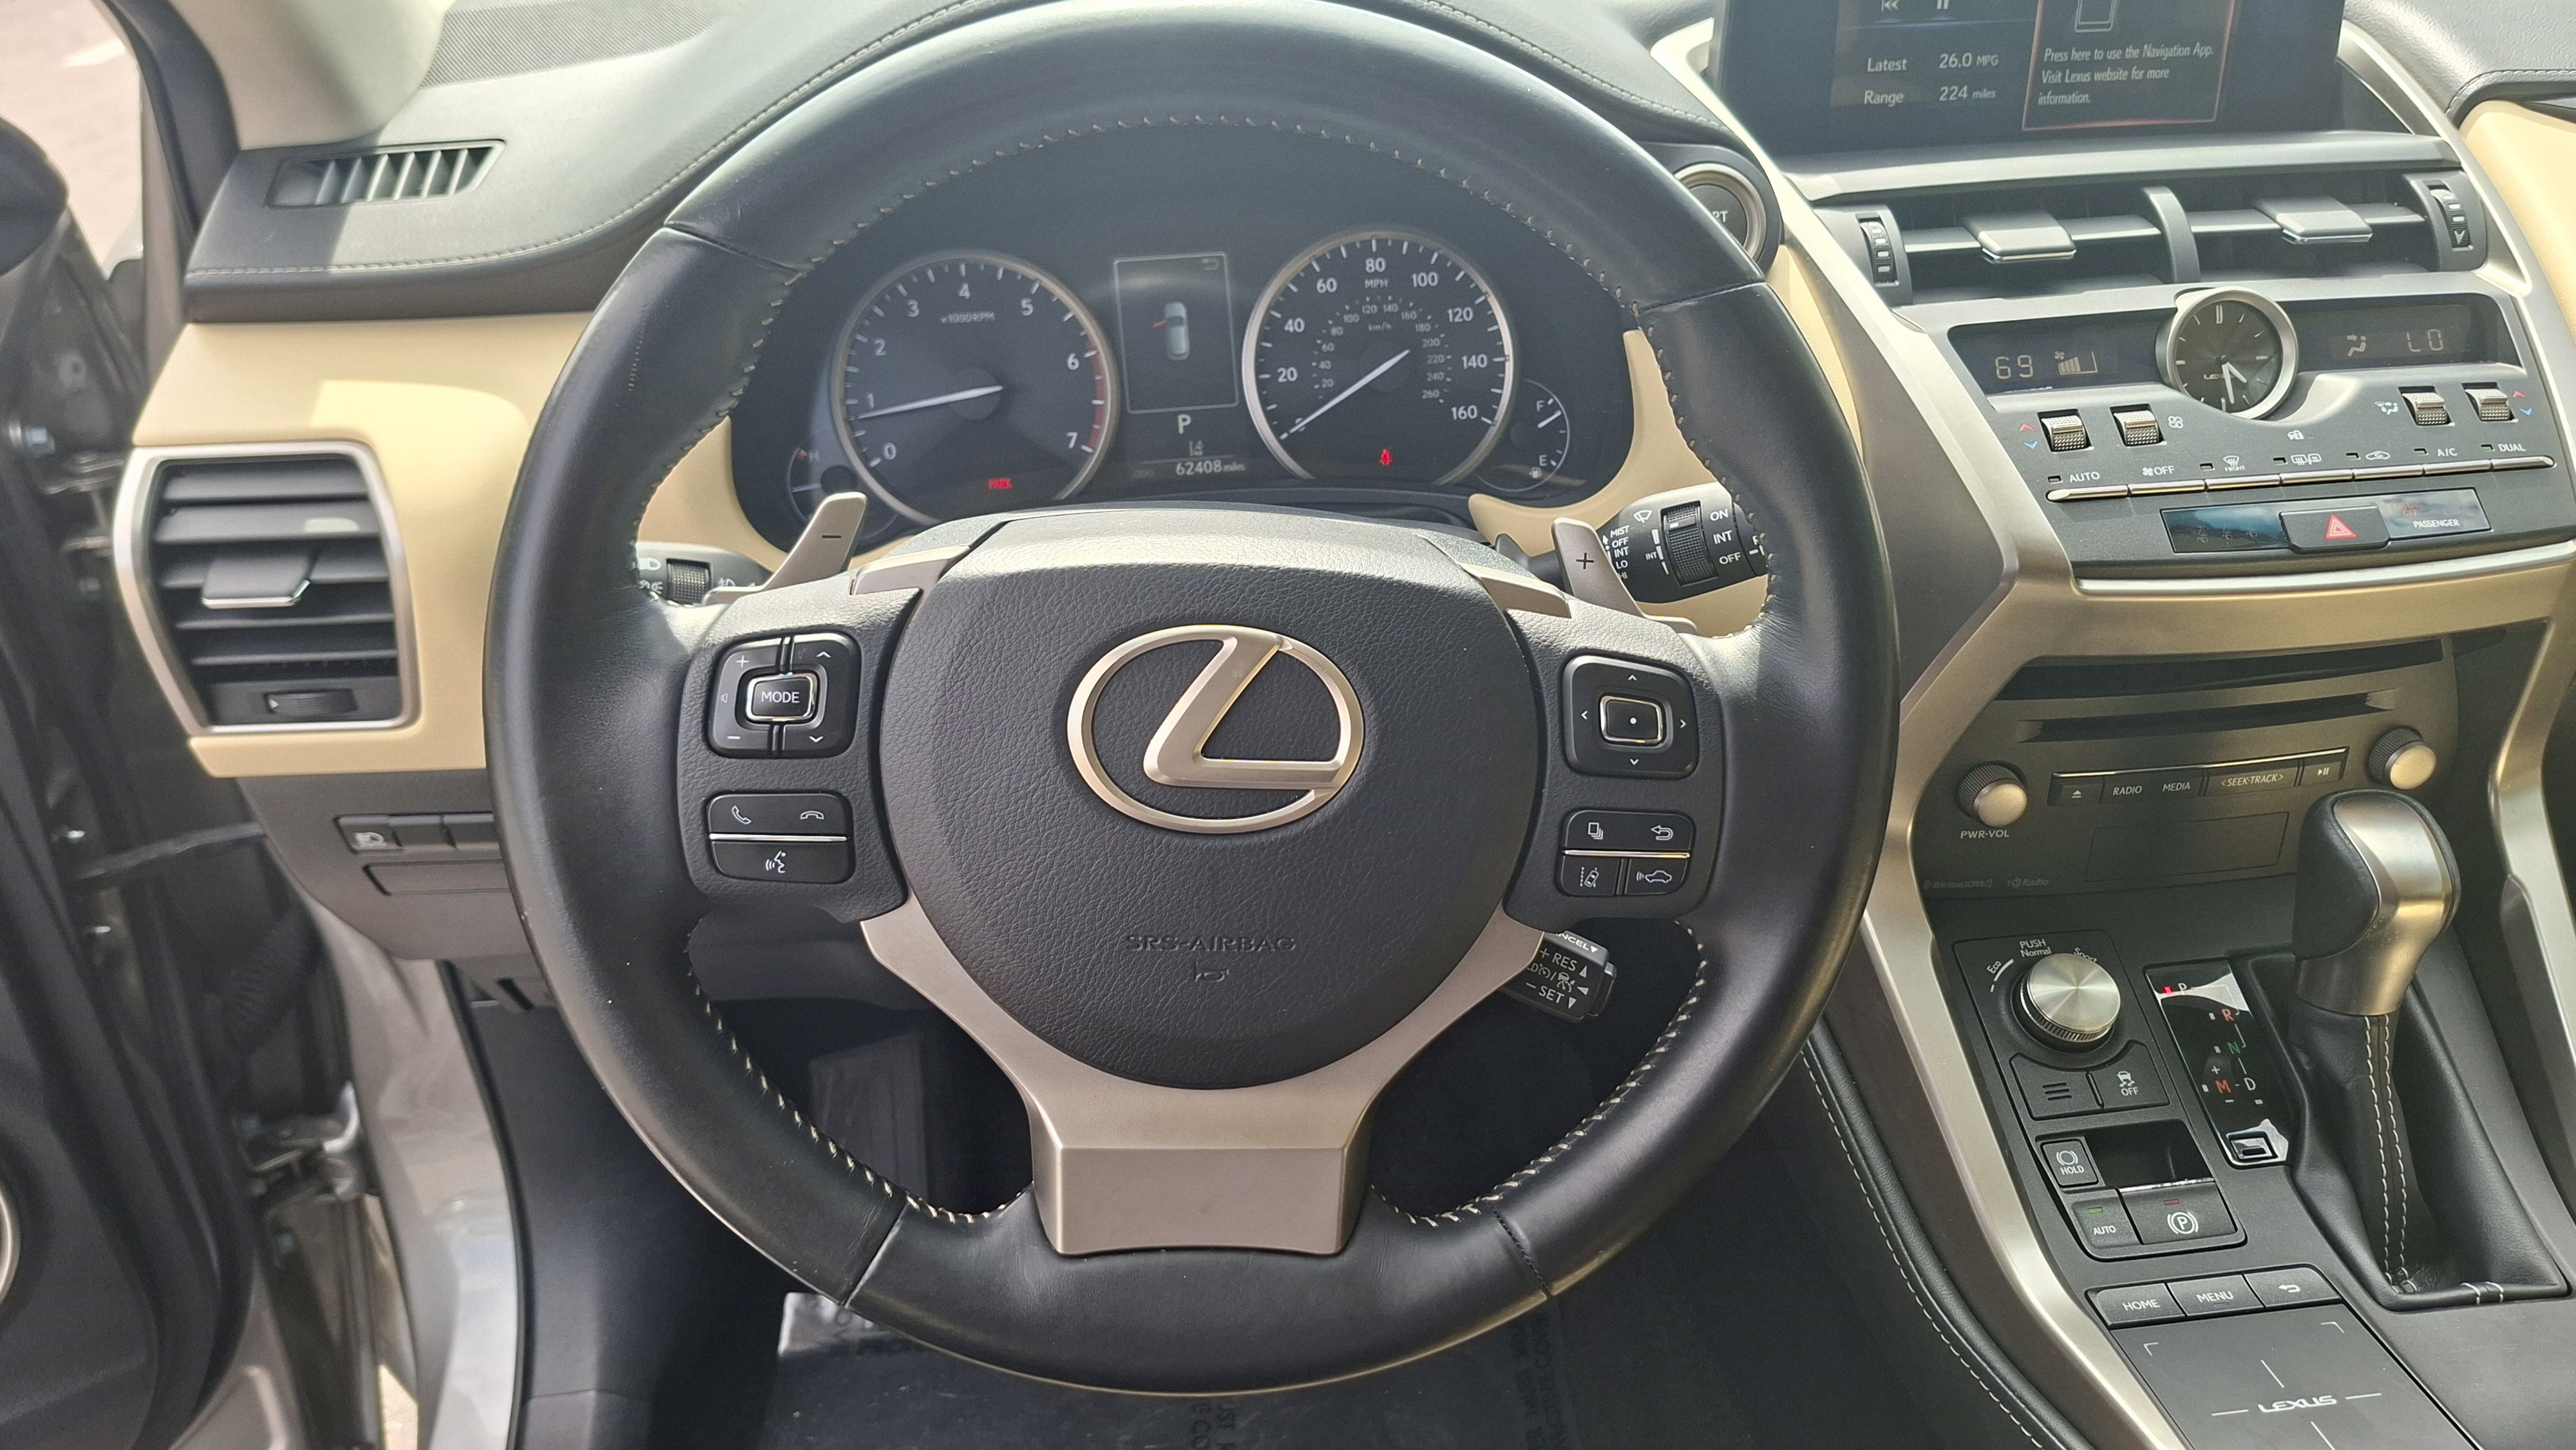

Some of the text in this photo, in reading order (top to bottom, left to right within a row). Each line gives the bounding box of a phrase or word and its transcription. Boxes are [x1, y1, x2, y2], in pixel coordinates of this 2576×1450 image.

[2044, 42, 2214, 62] Press here to use the Navigation App.
[1867, 57, 1907, 72] Latest
[1939, 52, 1998, 69] 26.0 MPG
[2041, 65, 2170, 84] Visit Lexus website for more
[1864, 90, 1904, 108] Range
[1939, 85, 1996, 101] 224 miles
[2038, 90, 2090, 106] information.
[1365, 257, 1386, 273] 80
[1316, 277, 1338, 293] 60
[1364, 278, 1388, 289] MPH
[1412, 271, 1439, 288] 100
[958, 283, 971, 299] 4
[907, 300, 920, 317] 3
[1021, 298, 1034, 316] 5
[1361, 305, 1378, 314] 120
[1383, 303, 1399, 313] 140
[1343, 313, 1360, 323] 100
[1401, 310, 1417, 321] 160
[1447, 306, 1474, 323] 120
[1284, 317, 1305, 333] 40
[1331, 326, 1343, 336] 80
[875, 340, 887, 355] 2
[1321, 342, 1334, 352] 60
[1421, 337, 1441, 348] 200
[1066, 352, 1079, 370] 6
[1318, 360, 1331, 370] 40
[1426, 354, 1445, 364] 220
[1462, 353, 1488, 370] 140
[1995, 353, 2034, 380] 69
[1277, 367, 1298, 382] 20
[1426, 371, 1444, 382] 240
[1321, 378, 1334, 388] 20
[1422, 388, 1440, 399] 260
[867, 393, 874, 408] 1
[1536, 400, 1544, 412] F
[1451, 404, 1478, 420] 160
[1177, 414, 1191, 434] P
[1066, 432, 1079, 449] 7
[884, 443, 896, 460] 0
[2437, 447, 2458, 457] A/C
[2498, 443, 2526, 453] DUAL
[1176, 459, 1222, 475] 62408
[1224, 462, 1245, 473] miles
[1539, 455, 1548, 467] E
[2069, 471, 2100, 483] AUTO
[2154, 465, 2174, 476] OFF
[1710, 509, 1728, 521] ON
[2413, 518, 2459, 529] PASSENGER
[1610, 525, 1630, 538] MIST
[1713, 530, 1732, 545] INT
[1612, 537, 1629, 548] OFF
[1614, 547, 1629, 558] INT
[1645, 551, 1658, 560] INT
[1719, 552, 1741, 565] OFF
[1616, 560, 1628, 569] LO
[761, 691, 800, 704] MODE
[2113, 785, 2142, 796] RADIO
[2163, 782, 2190, 792] MEDIA
[2023, 878, 2049, 887] Radio
[1126, 934, 1296, 952] SRS-AIRBAG
[1556, 933, 1589, 950] NCEL
[2020, 939, 2047, 949] PUSH
[2020, 946, 2052, 957] Normal
[1987, 961, 2002, 974] Eco
[1539, 985, 1565, 1003] SET
[2178, 983, 2187, 995] P
[2222, 1009, 2234, 1021] R
[2228, 1041, 2240, 1054] N
[2215, 1079, 2231, 1093] M
[2244, 1077, 2256, 1091] D
[2121, 1087, 2139, 1097] OFF
[2060, 1165, 2085, 1175] HOLD
[2093, 1225, 2116, 1235] AUTO
[2123, 1296, 2161, 1310] HOME
[2196, 1290, 2233, 1304] MENU
[2258, 1395, 2338, 1413] LEXUS
